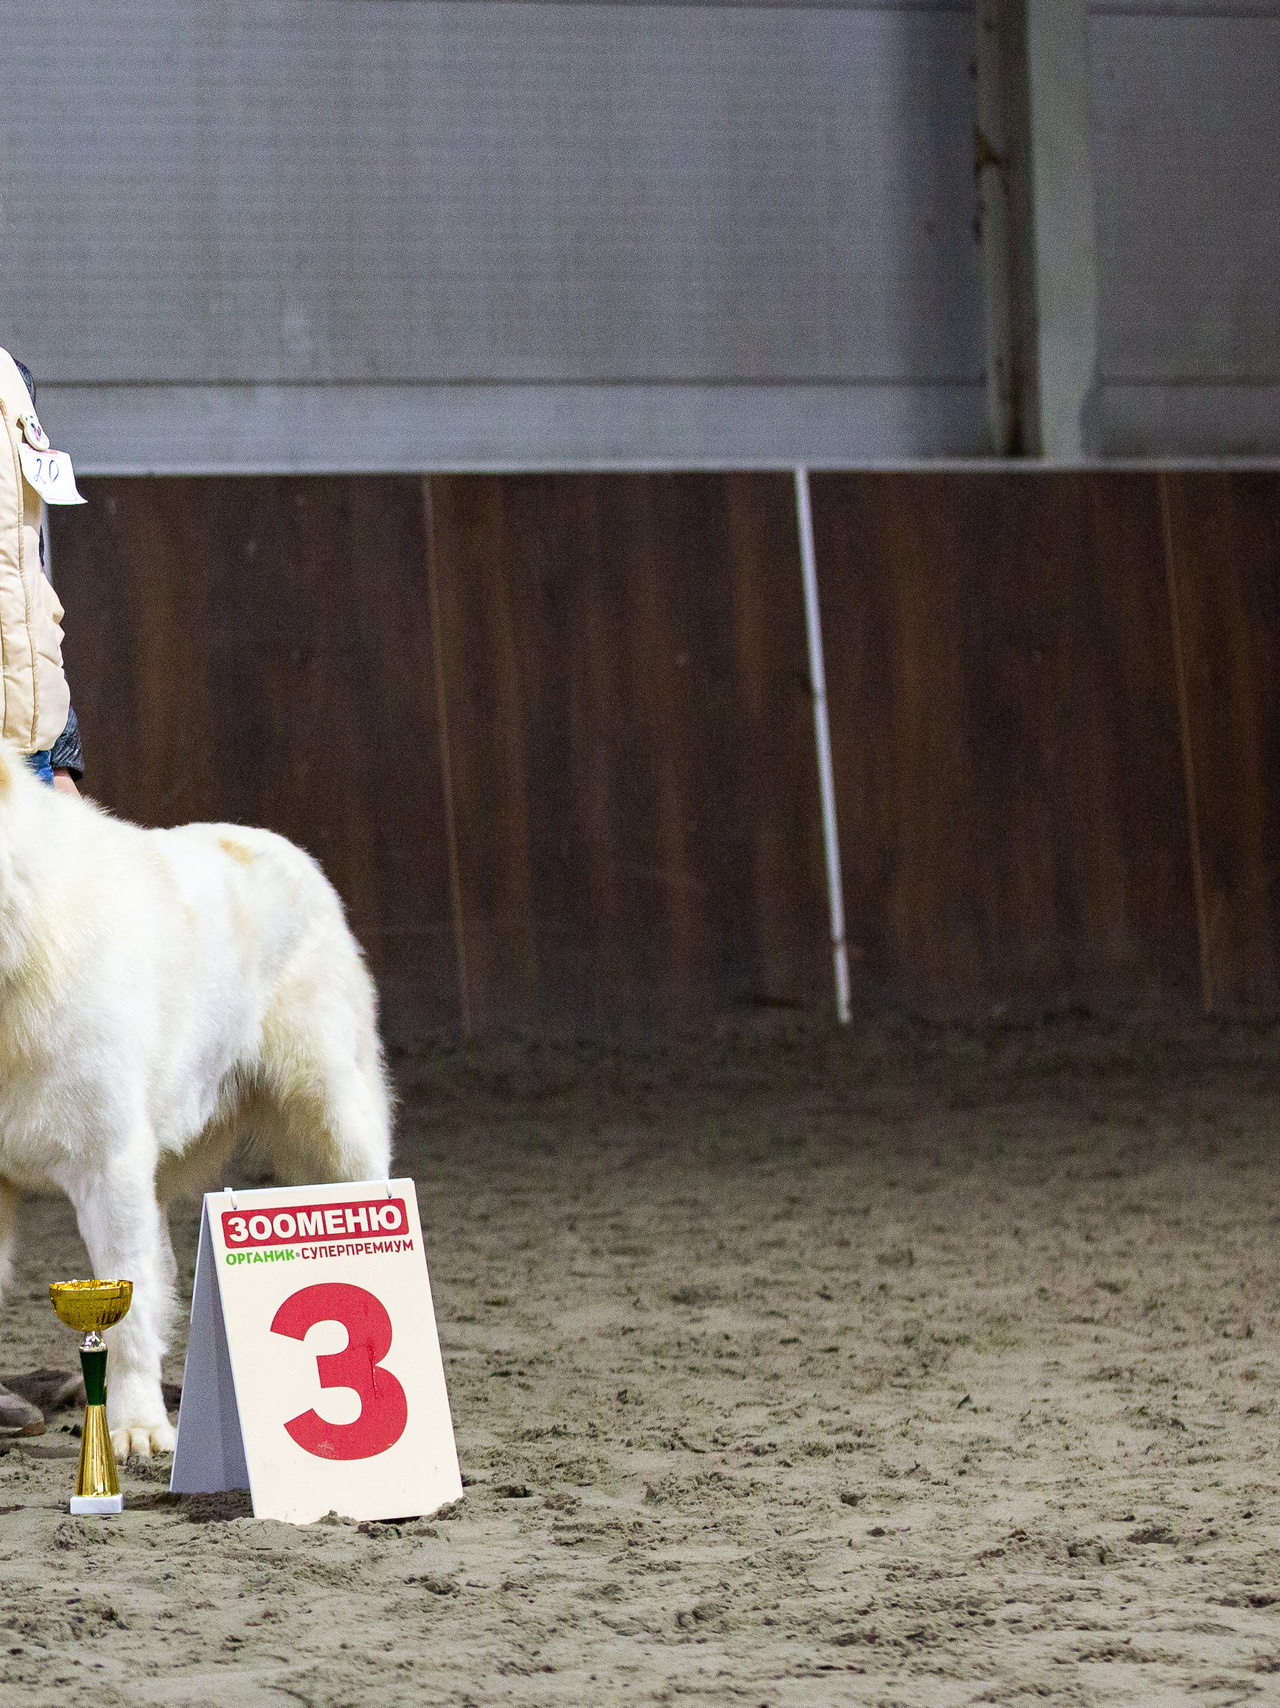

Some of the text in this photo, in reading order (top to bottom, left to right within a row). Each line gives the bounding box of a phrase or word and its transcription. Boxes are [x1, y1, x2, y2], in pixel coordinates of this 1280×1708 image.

[33, 458, 60, 485] 20
[227, 1204, 403, 1242] ЗООМЕНЮ
[269, 1282, 409, 1461] 3
